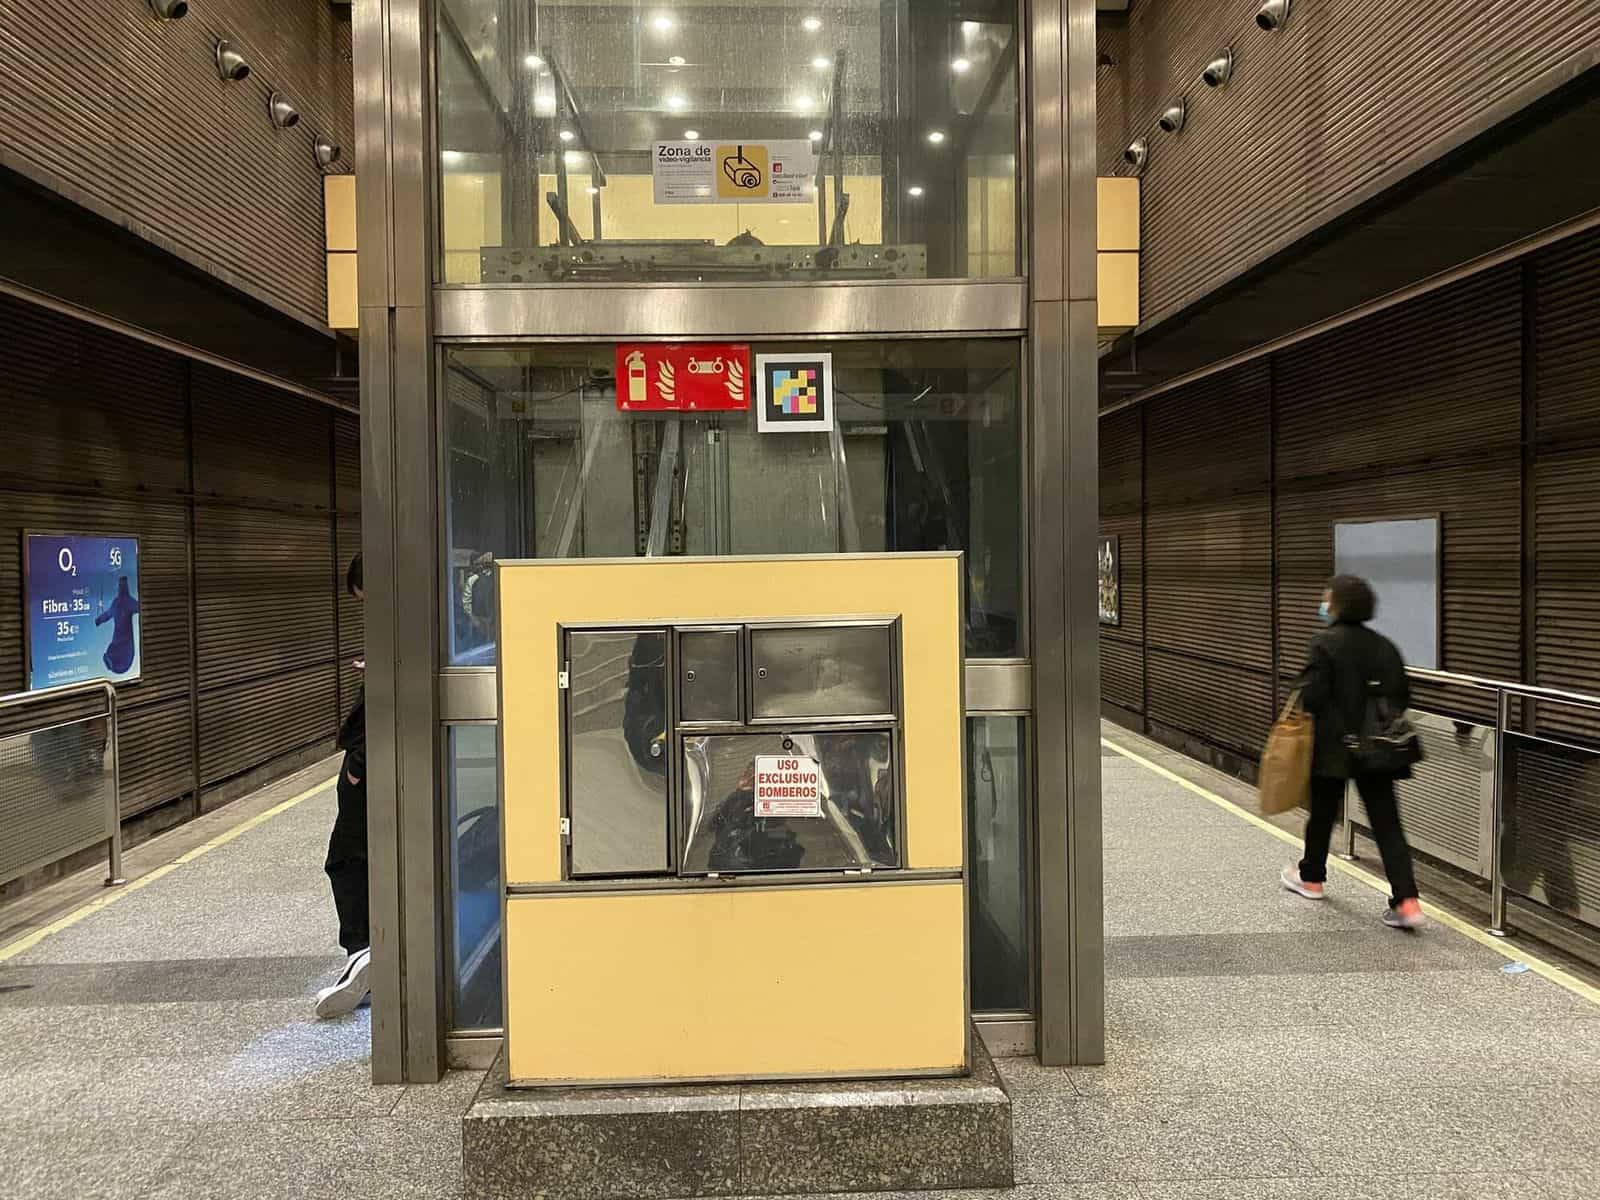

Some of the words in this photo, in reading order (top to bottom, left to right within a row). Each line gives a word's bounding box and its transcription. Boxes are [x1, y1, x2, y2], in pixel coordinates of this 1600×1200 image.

[658, 145, 691, 156] Zona
[695, 145, 711, 156] de
[109, 549, 122, 566] 5G
[42, 600, 68, 614] Fibra
[777, 759, 799, 770] USO
[758, 773, 817, 784] EXCLUSIVO
[758, 786, 817, 798] BOMBEROS
